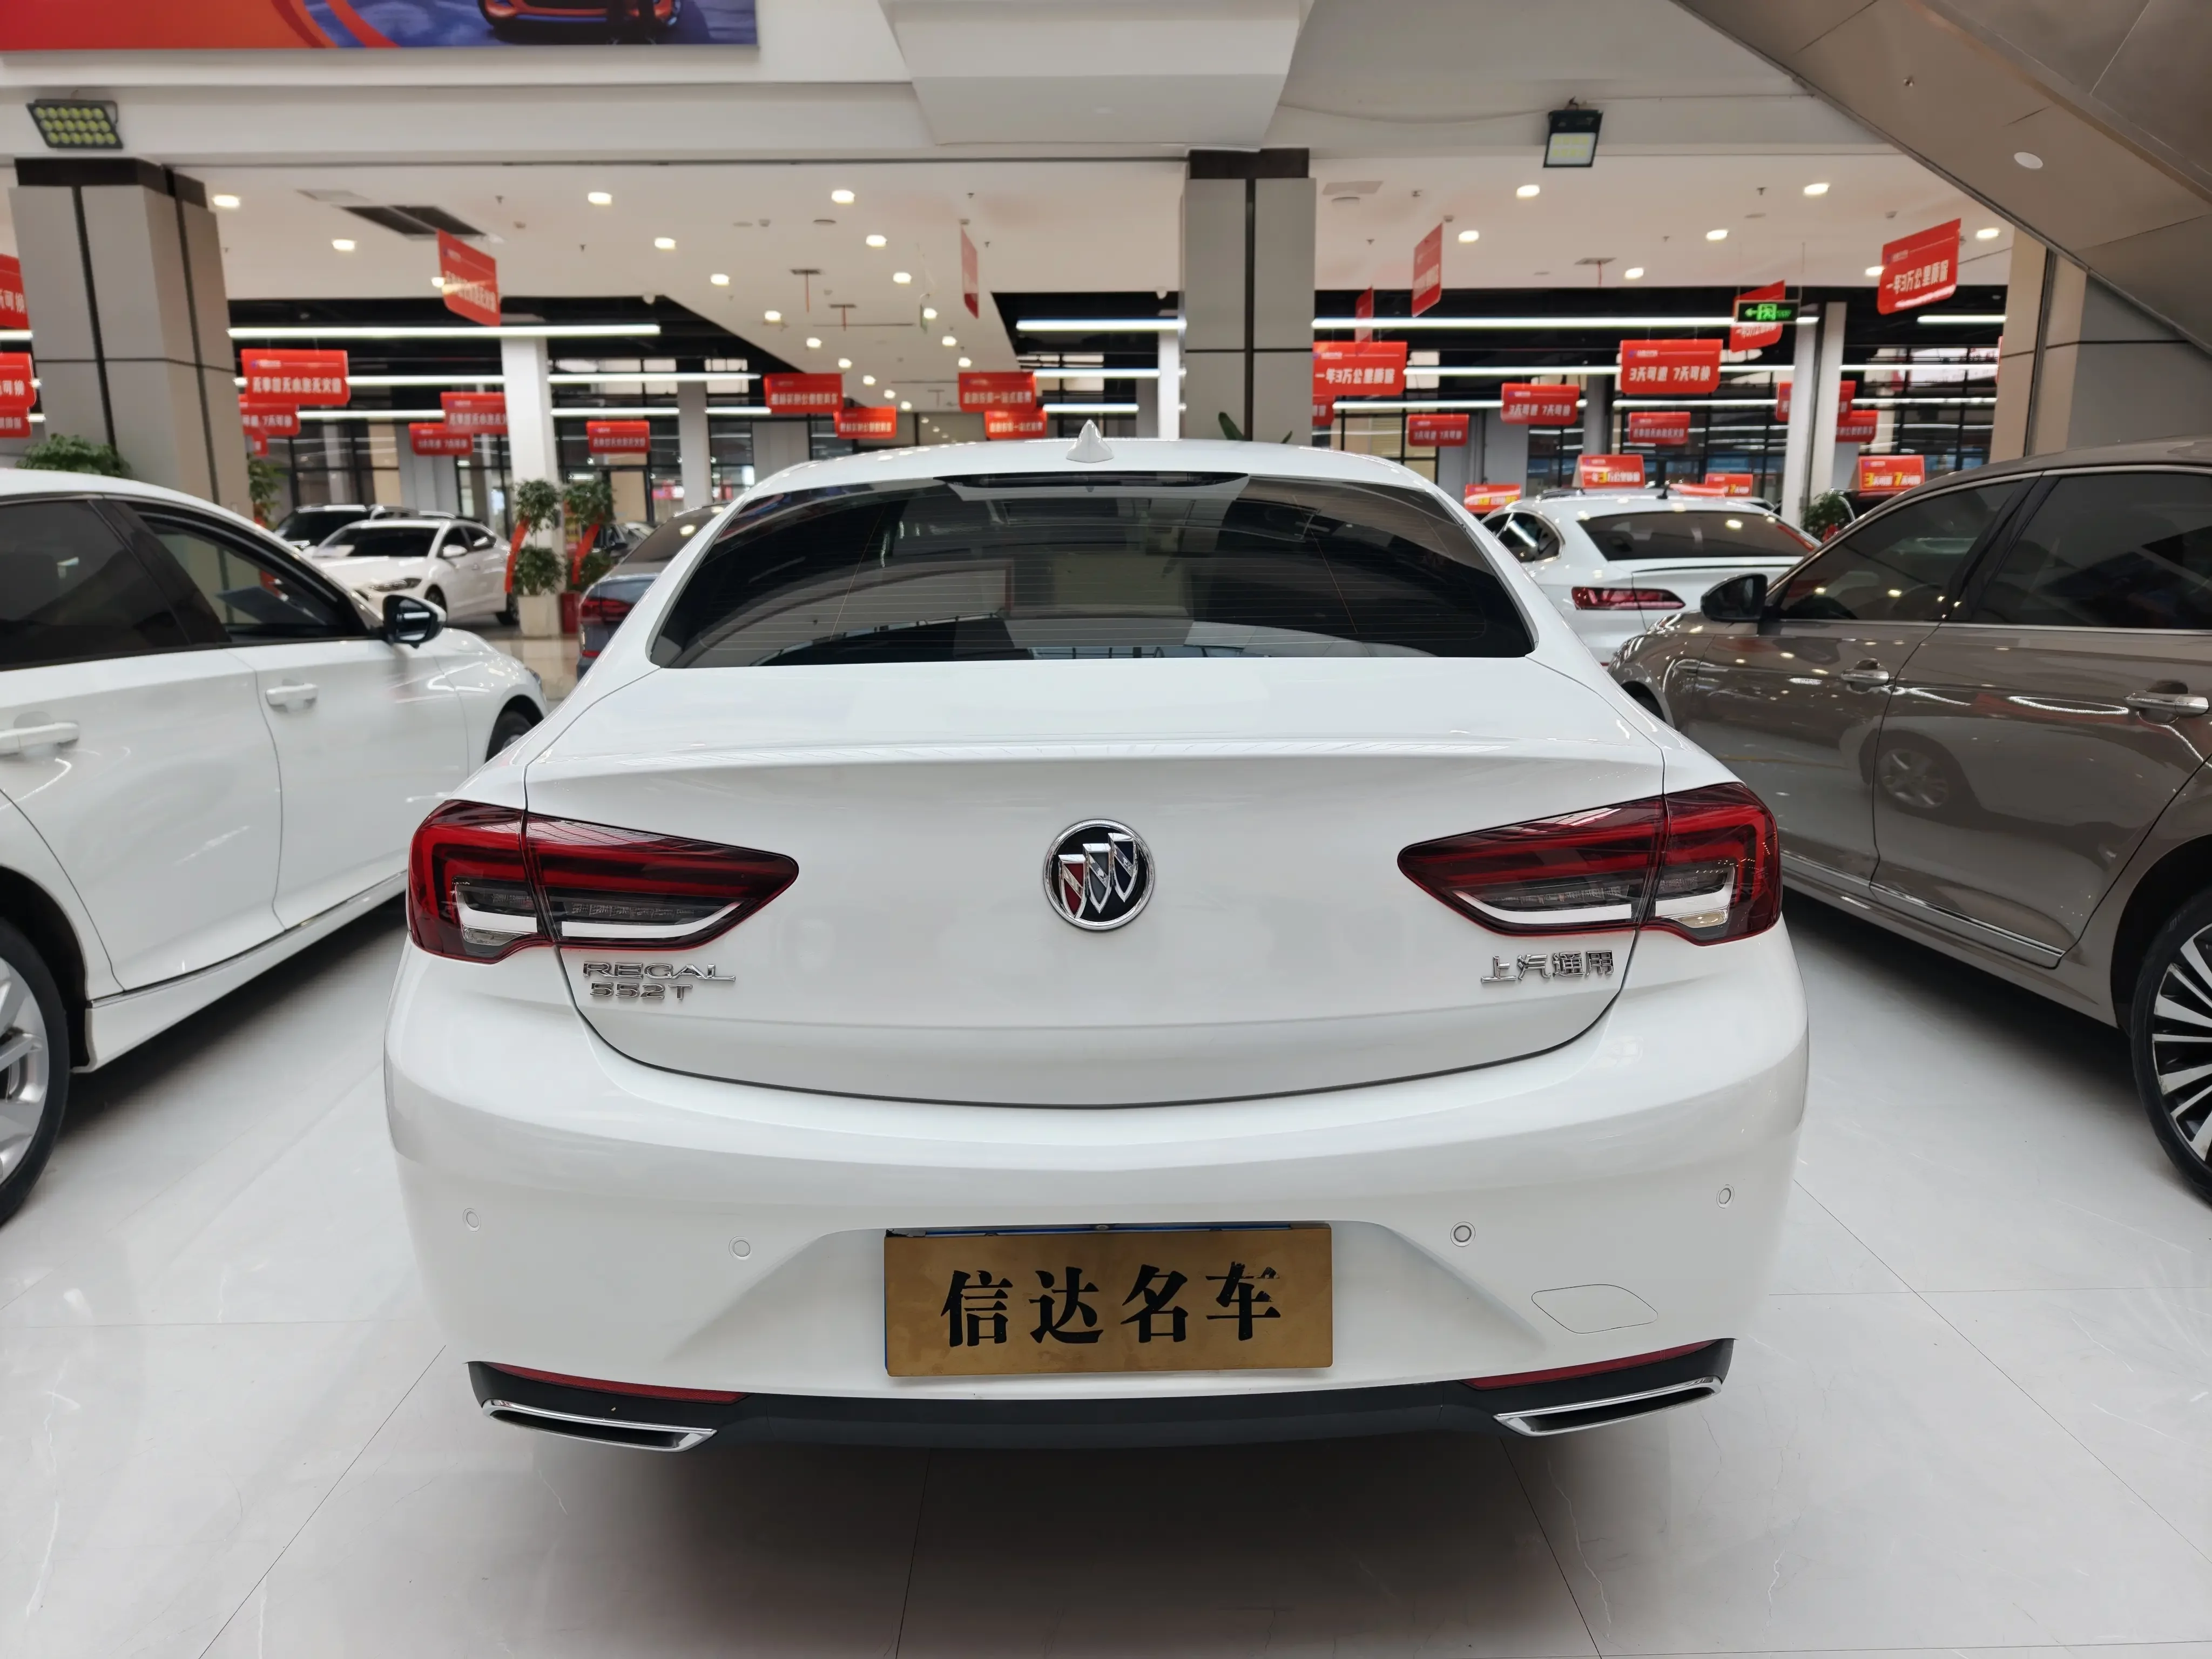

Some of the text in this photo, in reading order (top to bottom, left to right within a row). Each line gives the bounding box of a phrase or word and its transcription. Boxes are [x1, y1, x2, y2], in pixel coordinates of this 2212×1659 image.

[583, 961, 736, 981] REGAL
[1480, 950, 1614, 982] 上汽通用
[941, 1260, 1280, 1347] 信达名车
